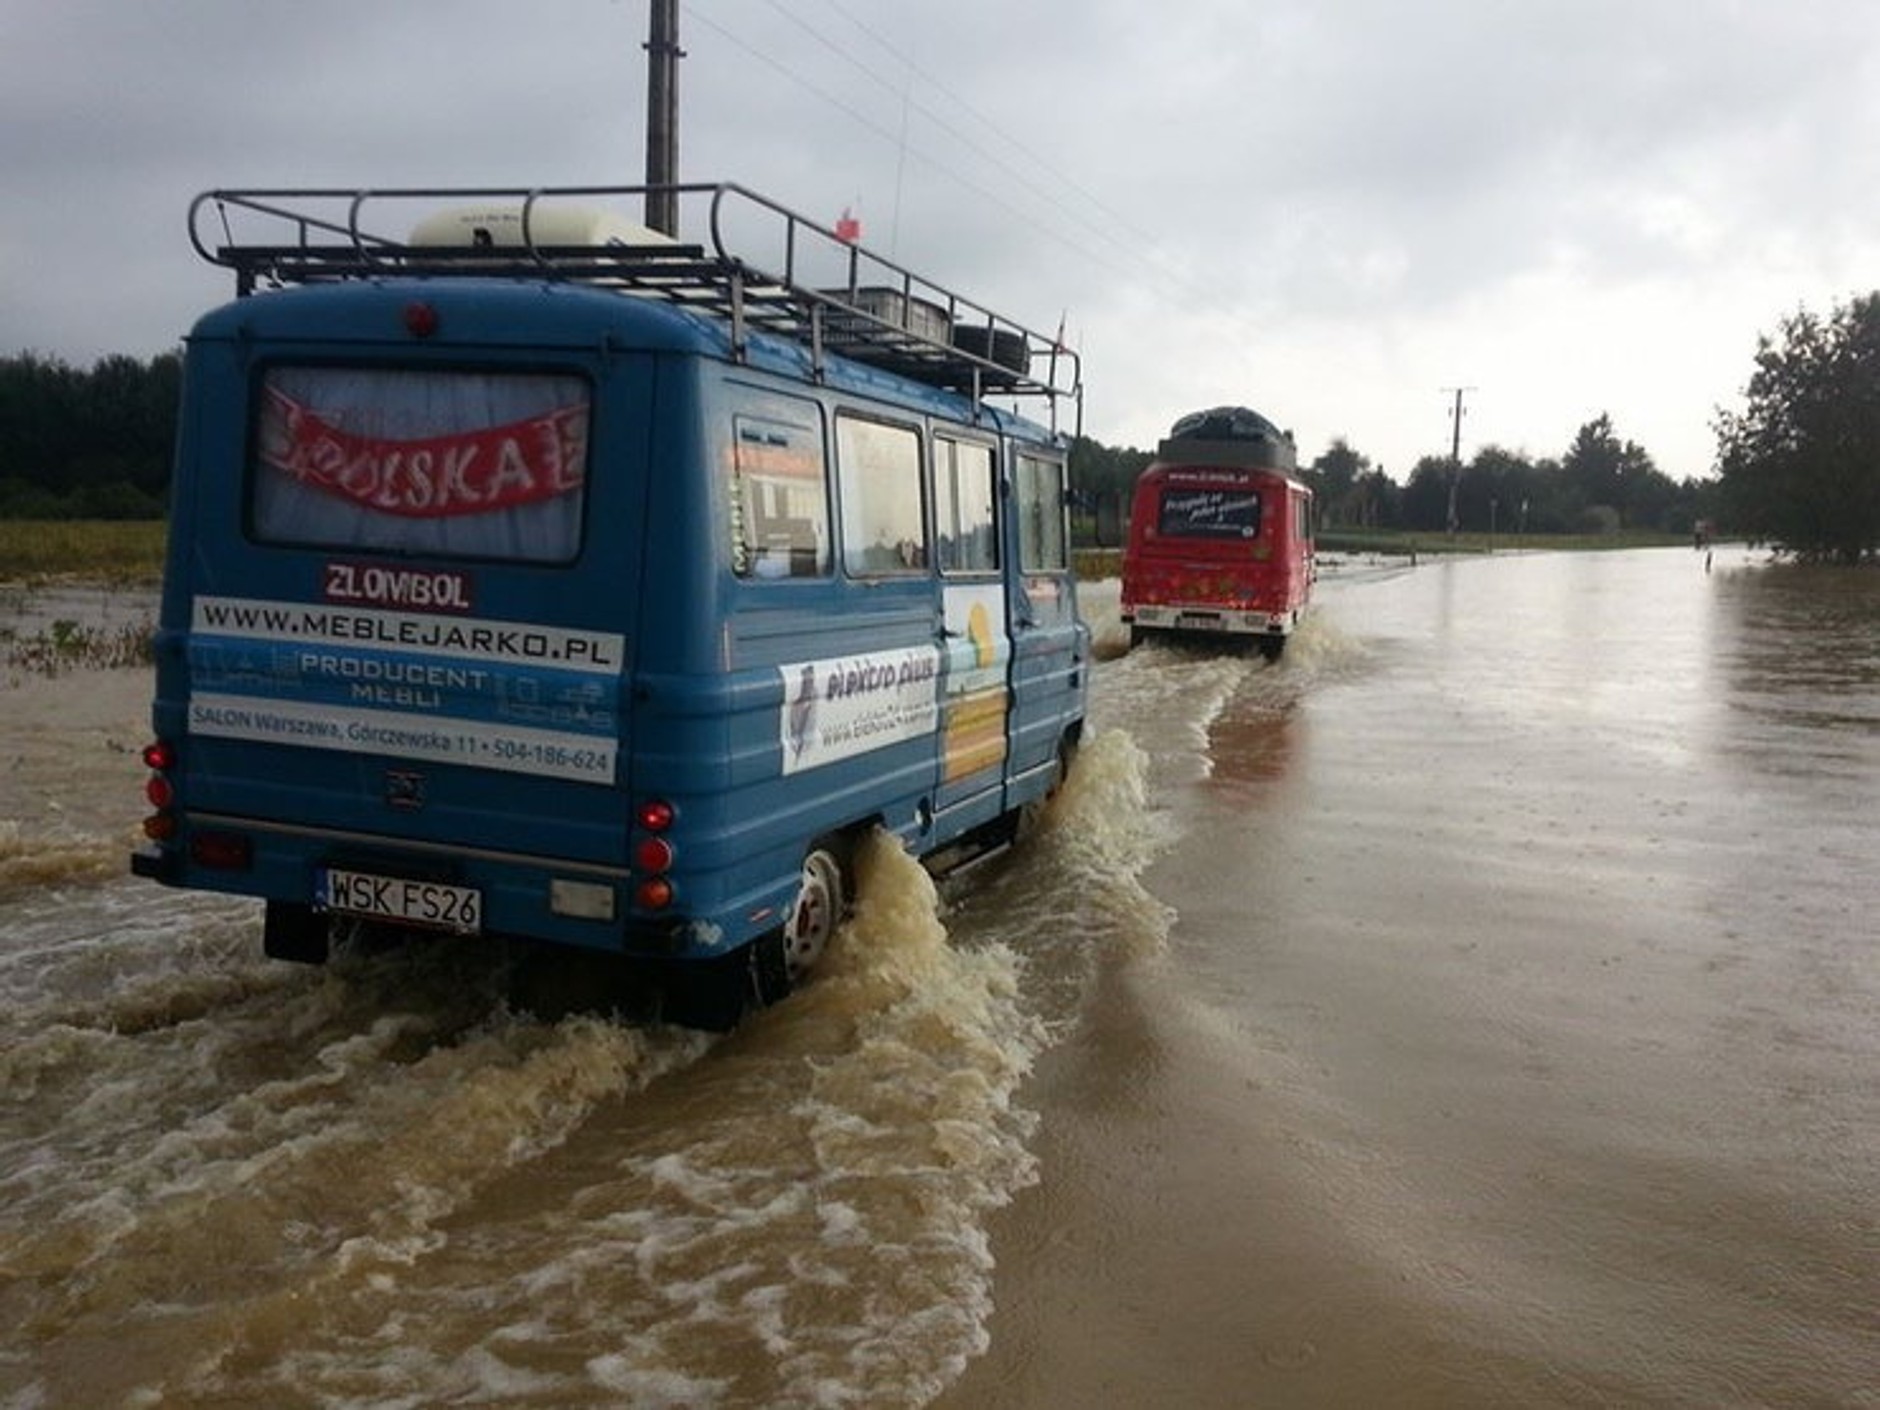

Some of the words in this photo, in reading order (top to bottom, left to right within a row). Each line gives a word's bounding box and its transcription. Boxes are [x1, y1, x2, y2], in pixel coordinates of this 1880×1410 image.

[303, 432, 534, 508] POLSKA
[326, 563, 470, 608] ZLOMBOL
[203, 604, 611, 665] WWW.MEBLEJARKO.PL
[299, 652, 488, 690] PRODUCENT
[350, 683, 440, 708] MEBLI
[193, 705, 251, 726] SALON
[255, 711, 344, 739] Warszawa,
[458, 737, 476, 753] 11
[493, 738, 608, 771] 504-186-624
[333, 873, 391, 914] WSK
[402, 883, 476, 924] FS26
